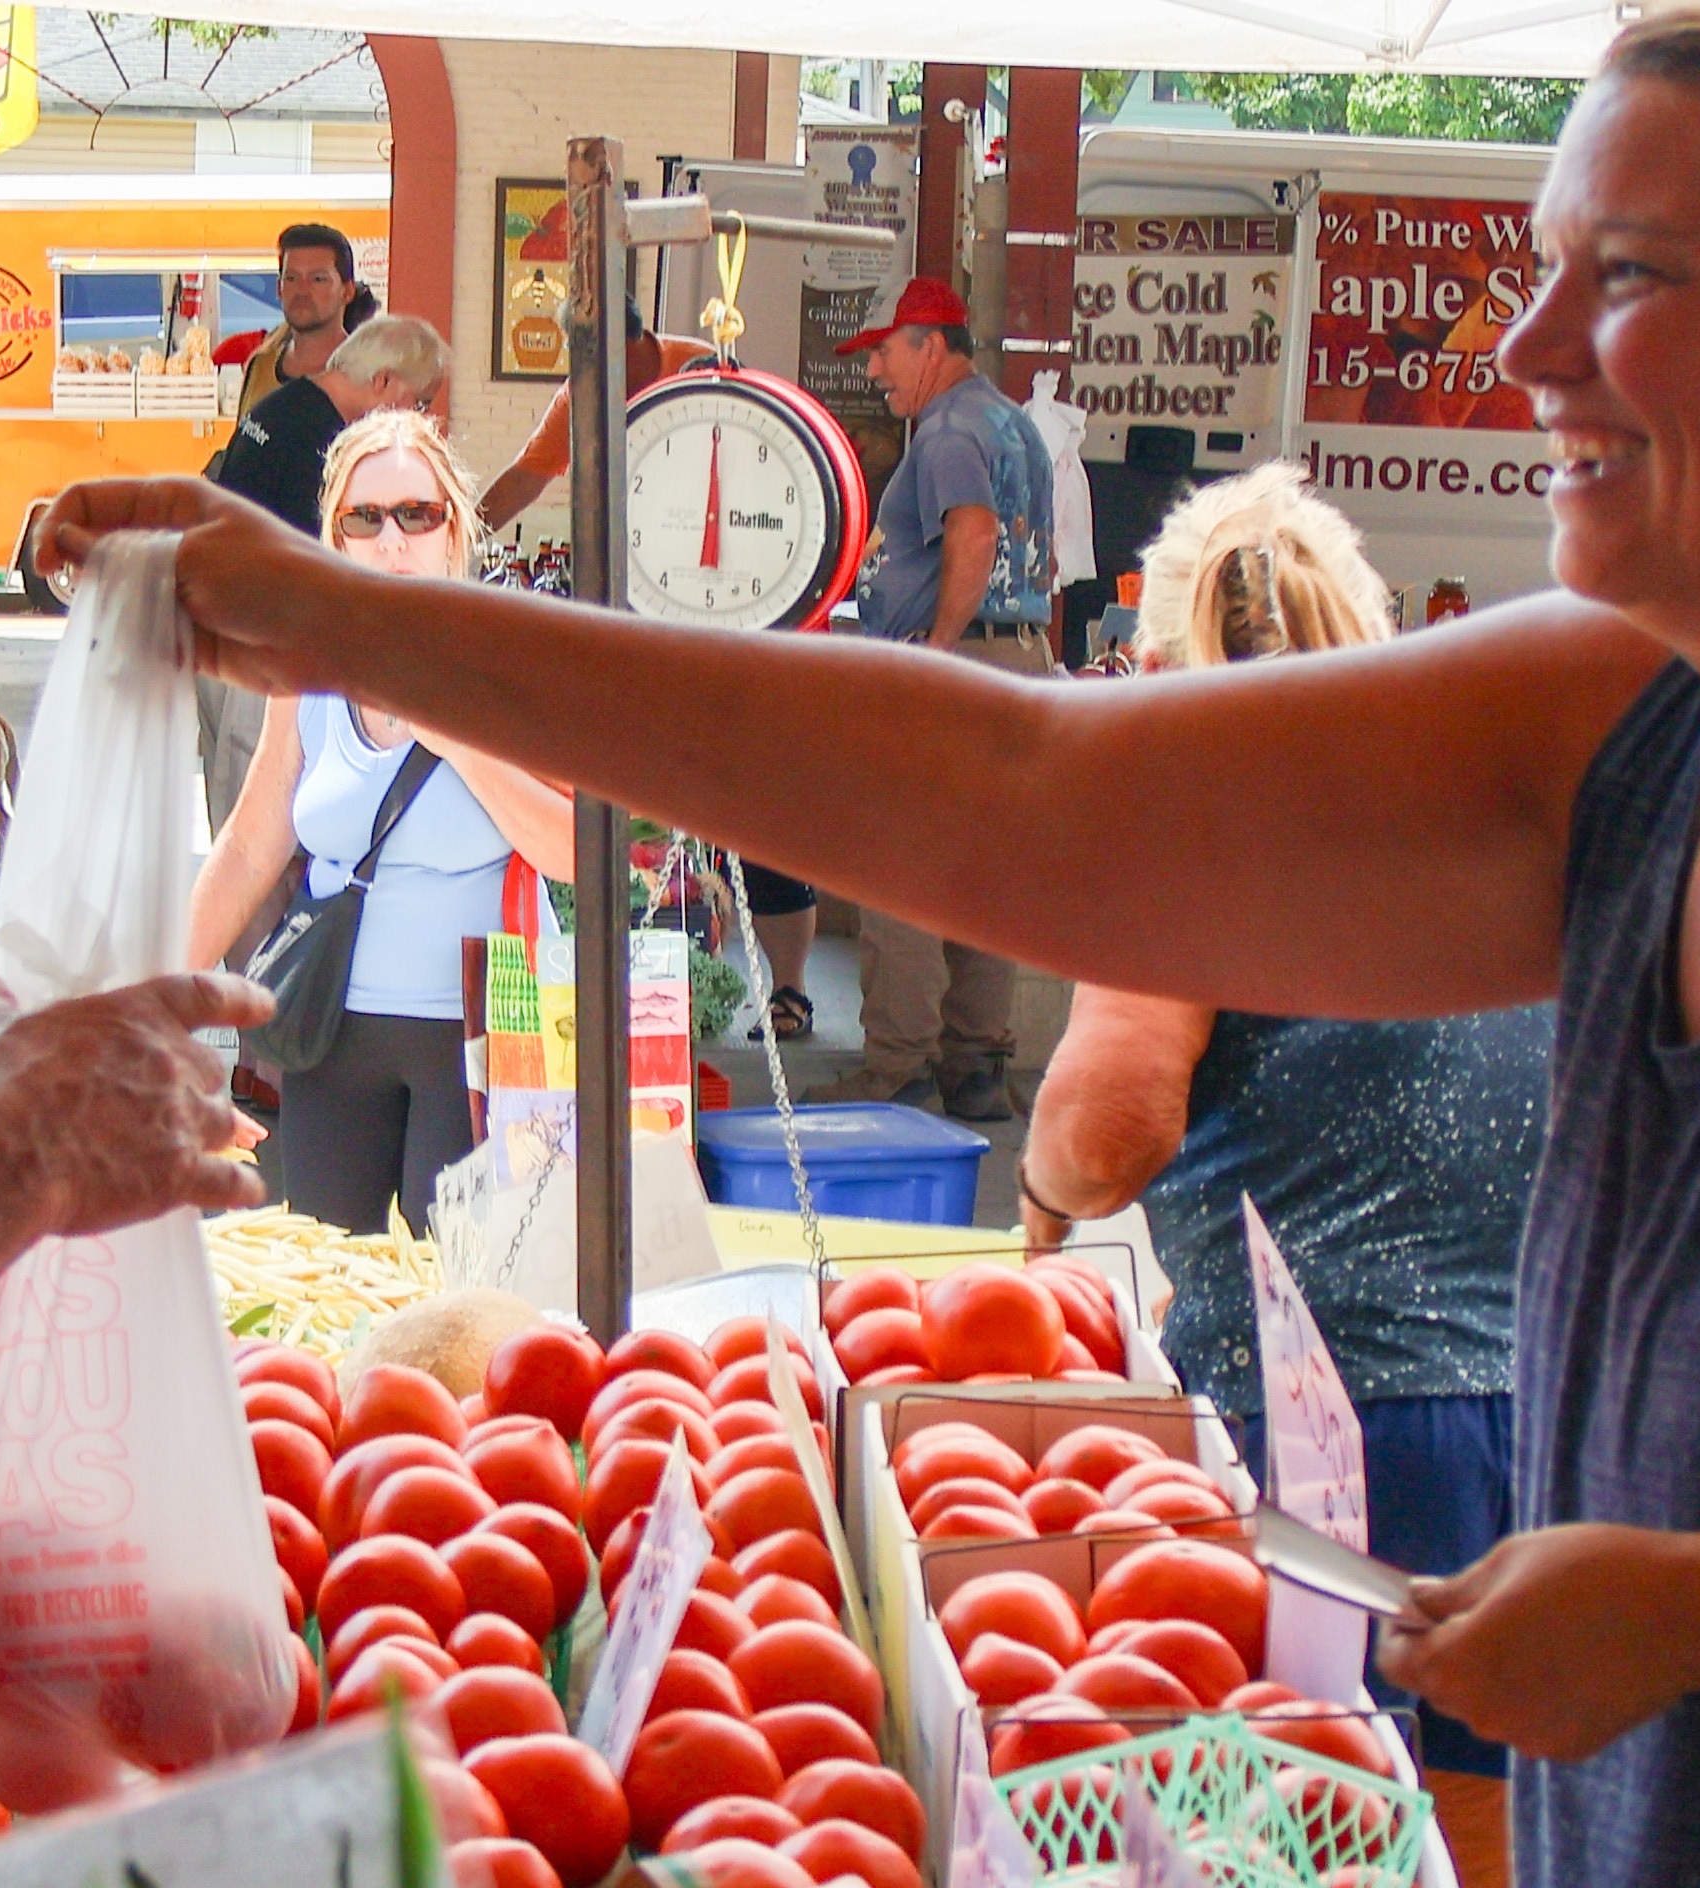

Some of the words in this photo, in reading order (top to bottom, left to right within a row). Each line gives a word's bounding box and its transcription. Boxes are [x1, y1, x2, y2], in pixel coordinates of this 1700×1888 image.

[1077, 218, 1120, 252] R
[1136, 217, 1279, 252] SALE
[1373, 208, 1472, 250] Pure
[830, 293, 850, 308] Ice
[1072, 281, 1116, 315] ce
[1126, 271, 1228, 315] Cold
[808, 307, 860, 323] Golden
[825, 323, 863, 338] Root
[1072, 323, 1142, 364] den
[1152, 323, 1281, 377] Maple
[806, 361, 846, 377] Simply
[1311, 346, 1498, 393] 15-675
[803, 376, 840, 393] Maple
[1072, 375, 1236, 417] ootbeer
[712, 424, 722, 444] 0
[666, 438, 670, 456] 1
[758, 445, 768, 463] 9
[1303, 441, 1554, 496] dmore.co
[634, 476, 643, 495] 2
[786, 486, 795, 505] 8
[729, 509, 783, 530] Chatillon
[632, 530, 641, 548] 3
[786, 541, 794, 560] 7
[659, 571, 668, 589] 4
[752, 578, 761, 597] 6
[706, 590, 714, 608] 5
[43, 1582, 149, 1625] RECYCLING
